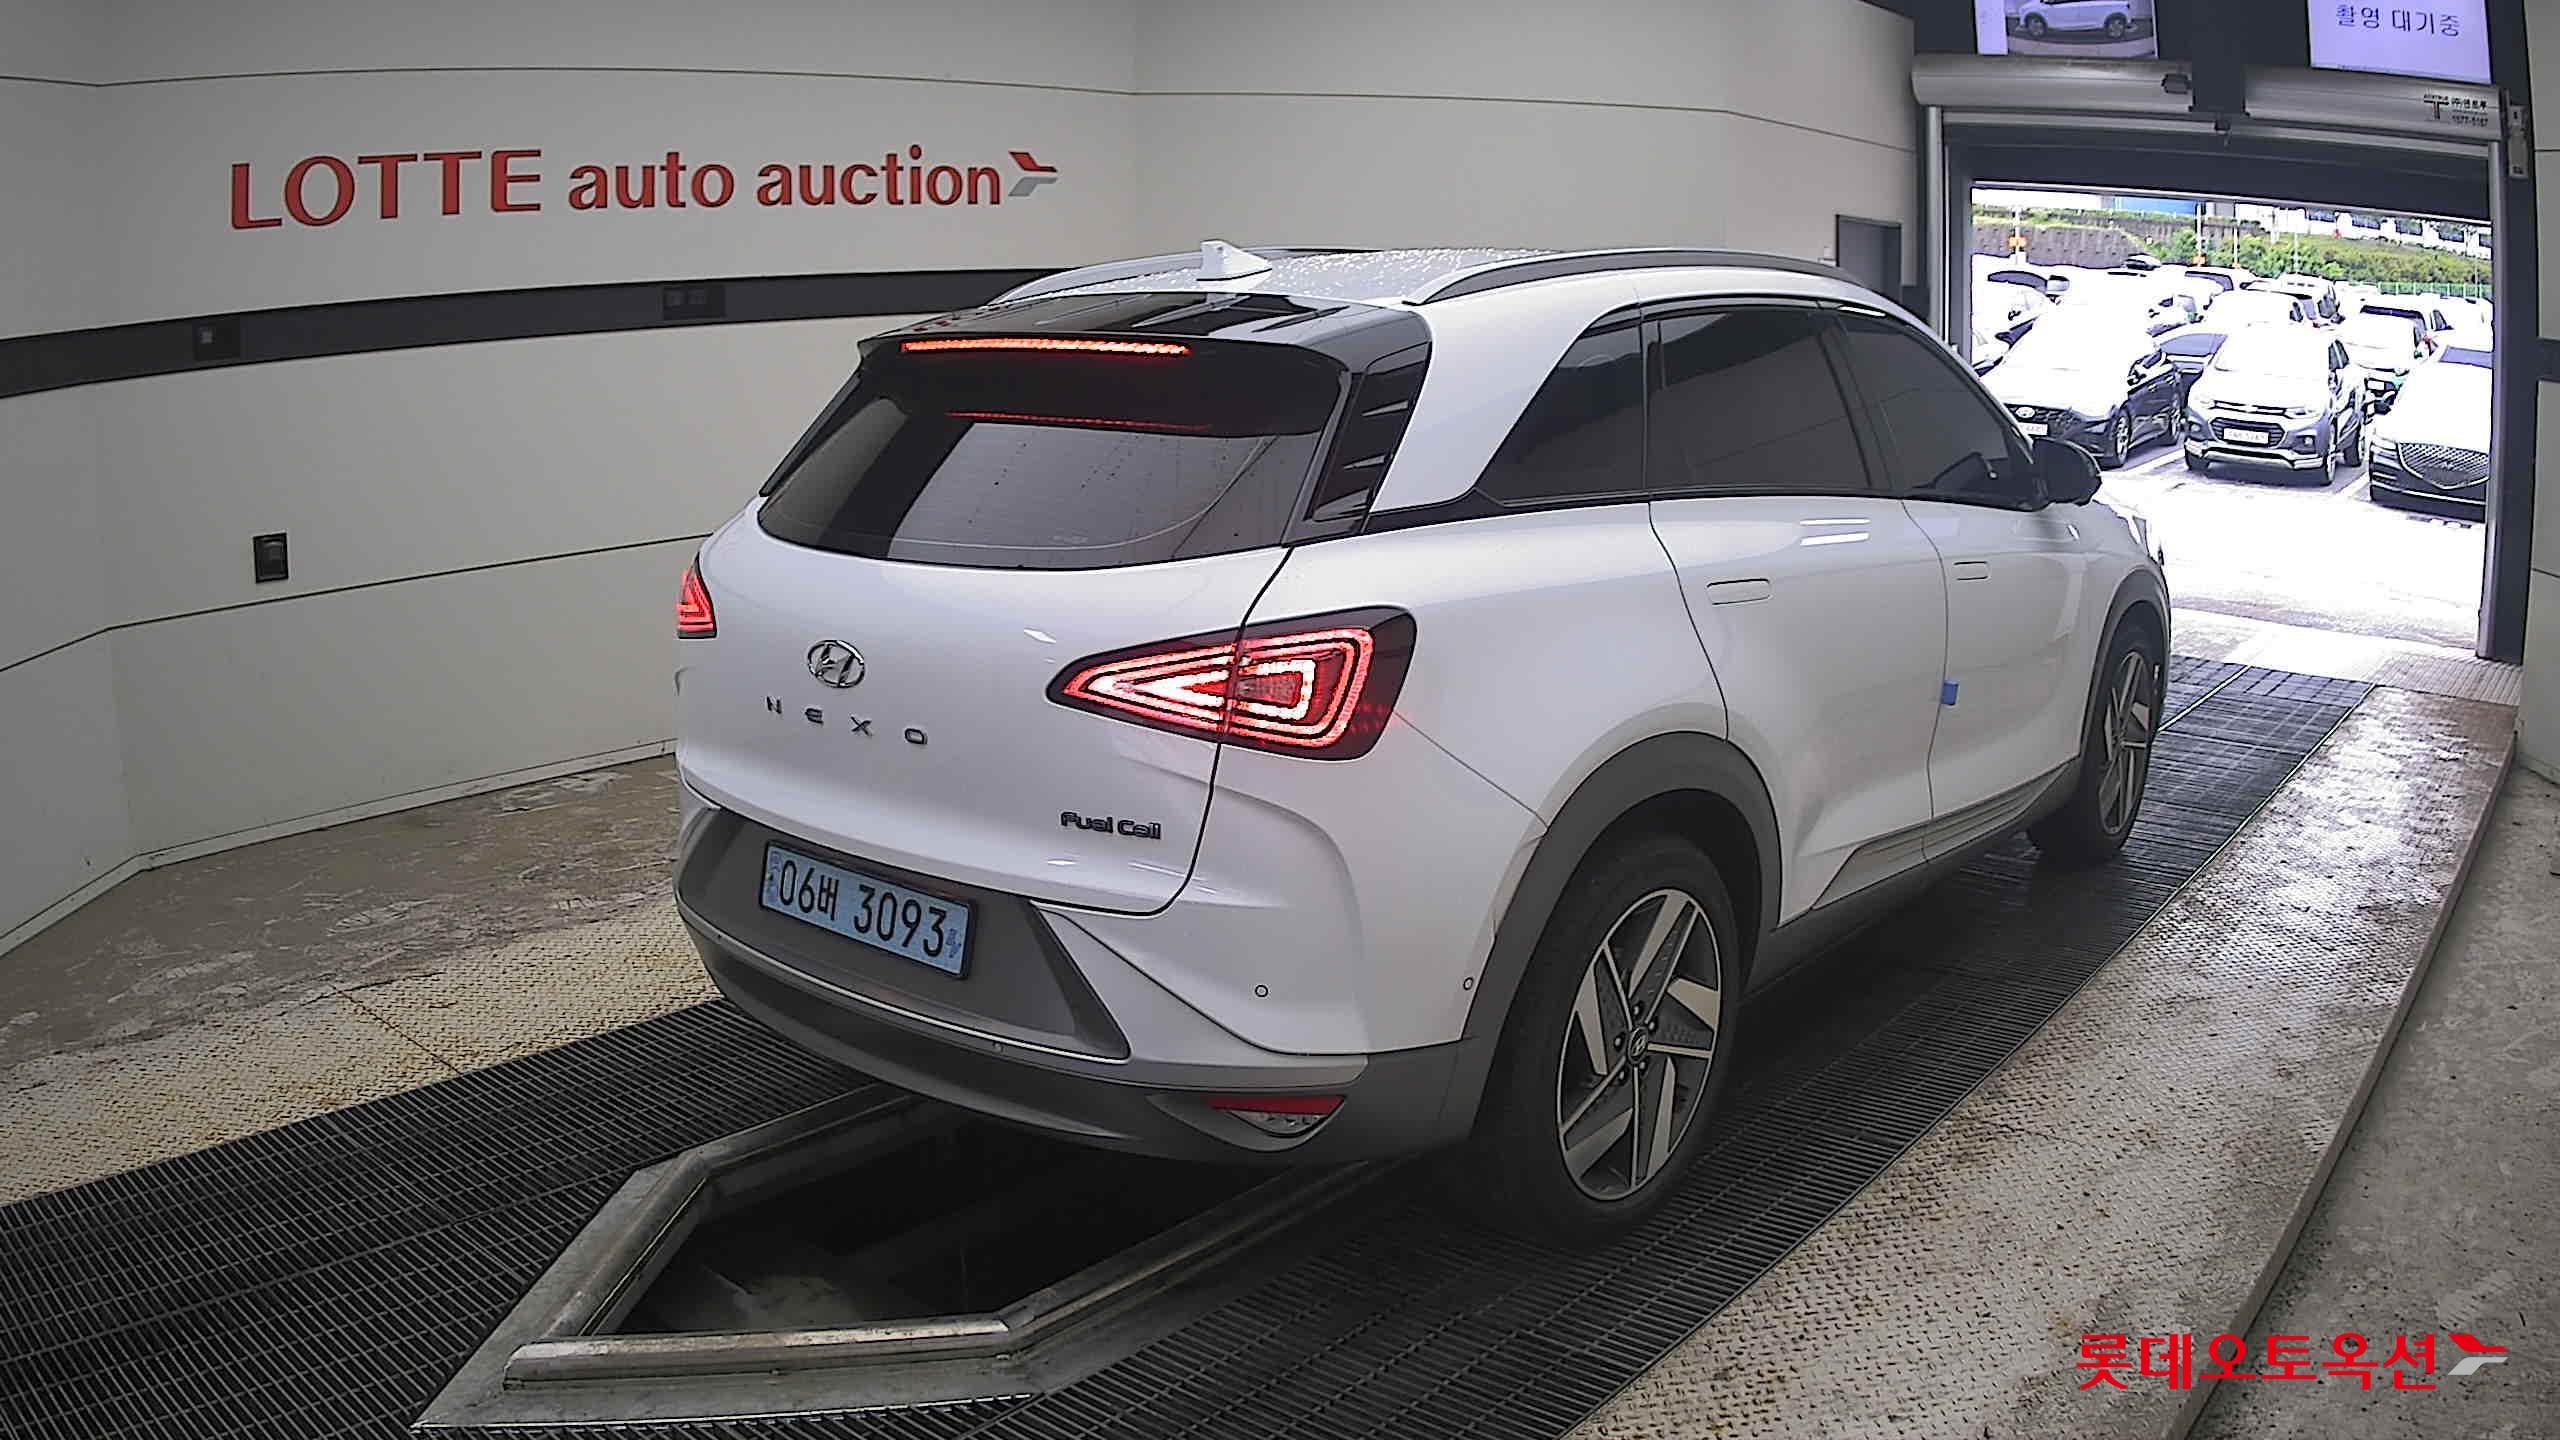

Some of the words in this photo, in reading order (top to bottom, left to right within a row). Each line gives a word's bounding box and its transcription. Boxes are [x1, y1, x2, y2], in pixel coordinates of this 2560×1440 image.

[2336, 4, 2380, 29] 촬영
[2392, 8, 2460, 37] 대기중
[231, 149, 542, 230] LOTTE
[568, 151, 735, 210] auto
[756, 144, 1001, 206] auction
[766, 696, 928, 745] NEXO
[1060, 811, 1114, 834] Fuel
[1117, 819, 1162, 840] Cell
[779, 860, 839, 921] 06버
[854, 884, 947, 957] 3093
